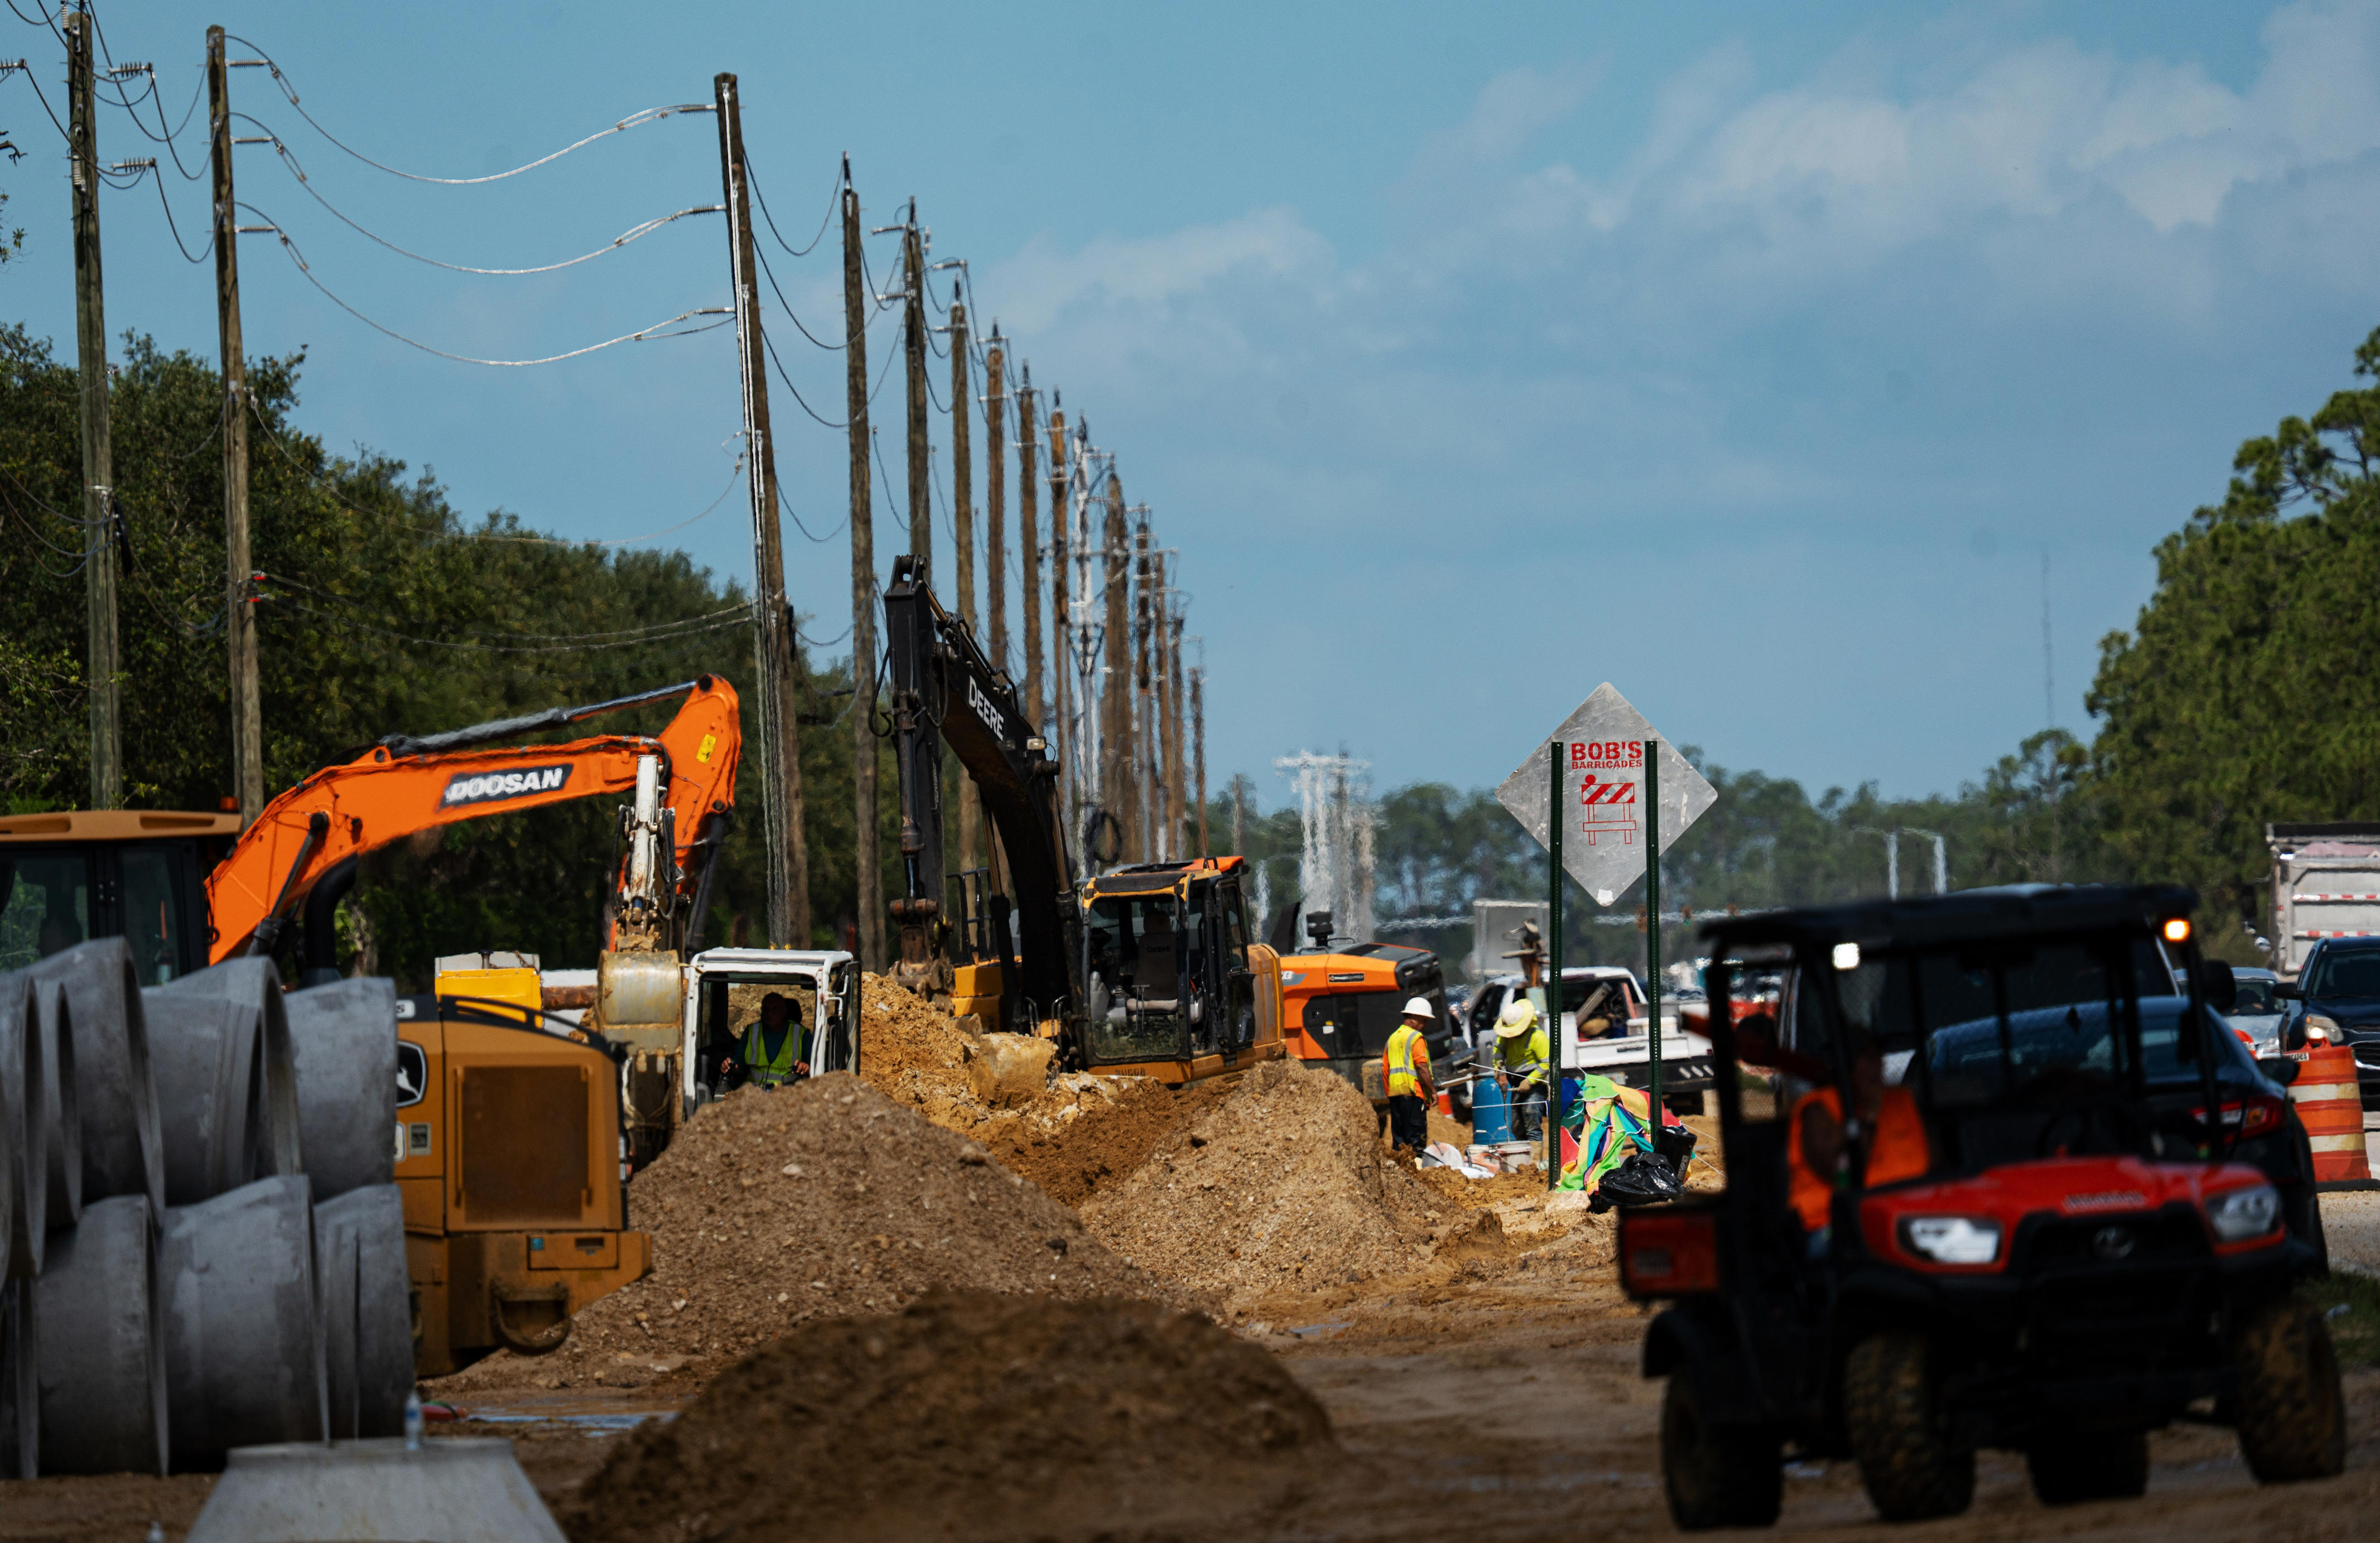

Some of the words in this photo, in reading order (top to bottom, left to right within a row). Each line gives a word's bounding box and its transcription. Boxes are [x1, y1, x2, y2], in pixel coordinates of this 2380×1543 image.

[968, 675, 1005, 741] DEERE
[1571, 741, 1642, 761] BOB'S
[1572, 760, 1642, 770] BARRICADES
[444, 767, 563, 803] DOOSAN
